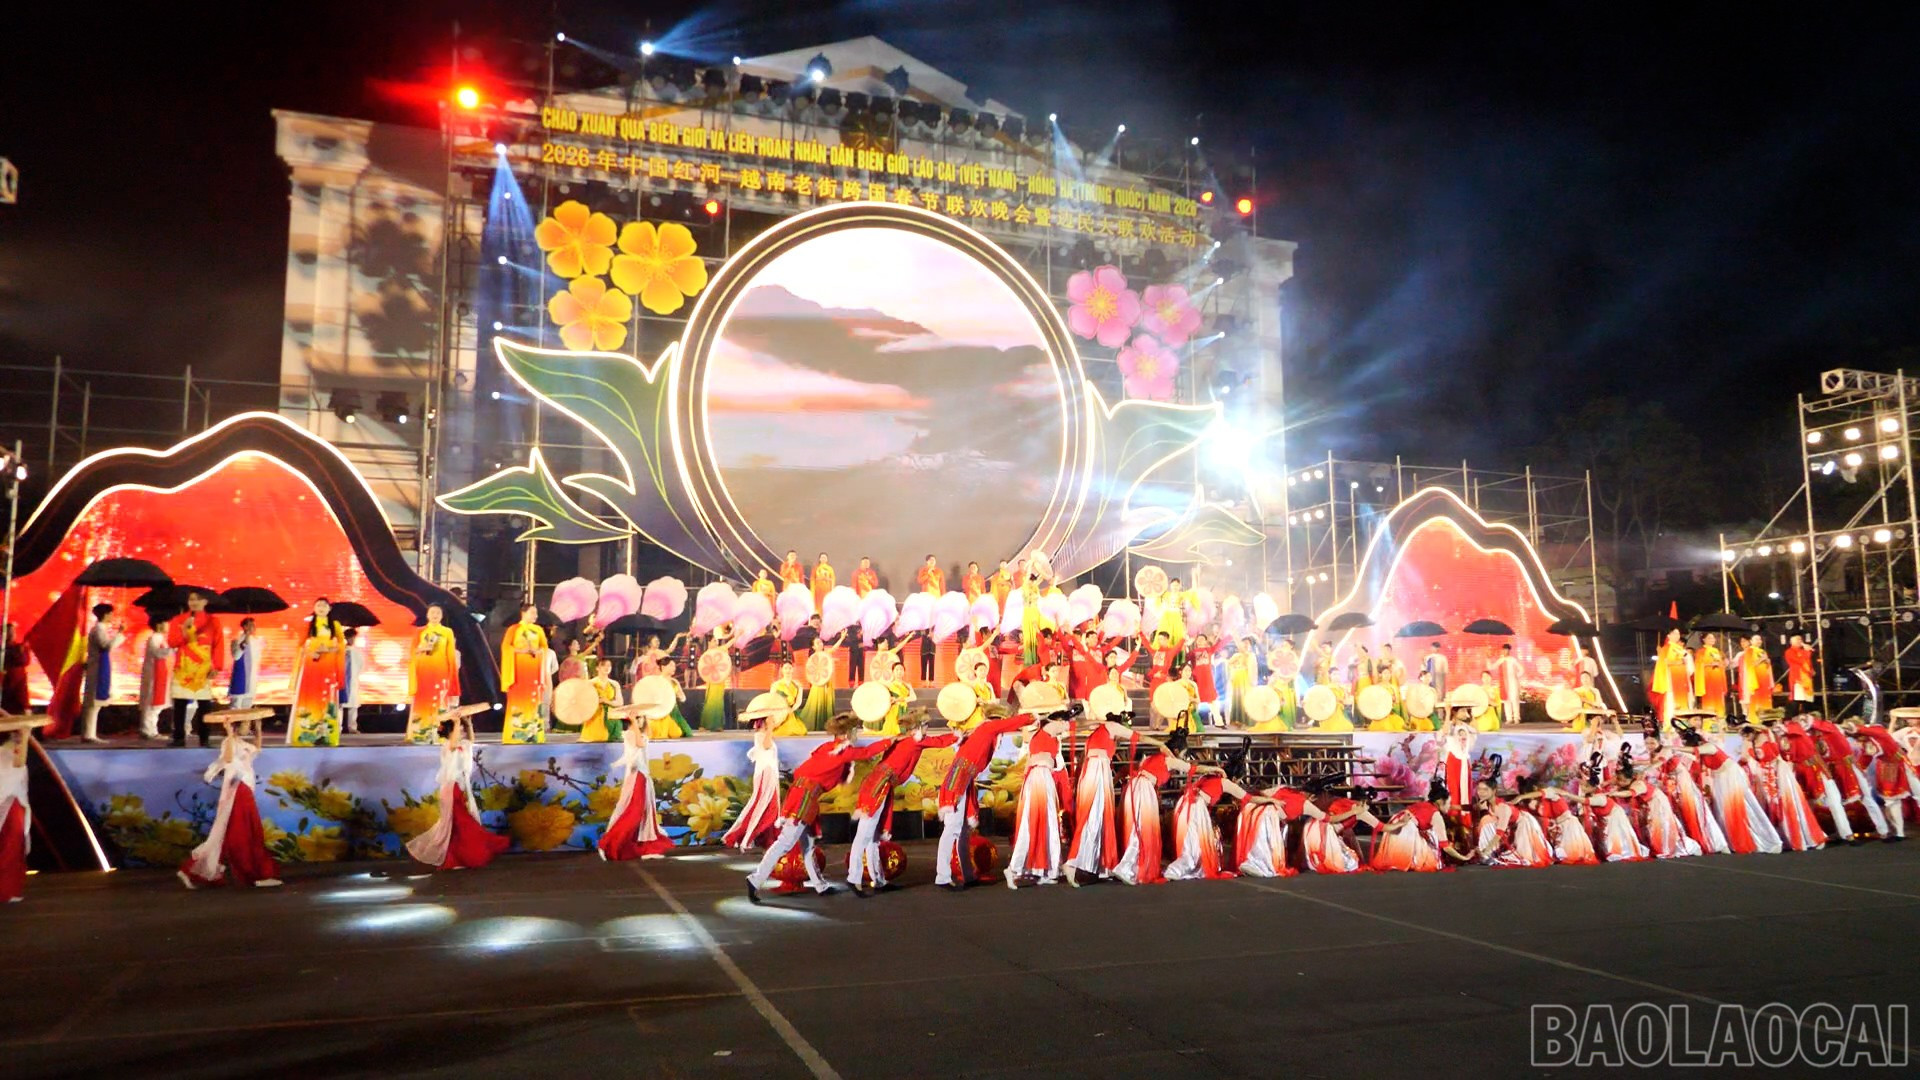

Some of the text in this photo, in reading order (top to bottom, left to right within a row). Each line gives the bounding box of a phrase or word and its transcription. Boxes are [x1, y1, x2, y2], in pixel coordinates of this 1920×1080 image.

[580, 111, 617, 137] XUÂN
[649, 120, 678, 144] BIÊN
[729, 130, 755, 155] LIÊN
[758, 137, 791, 159] HOAN
[794, 139, 827, 164] NHÂN
[830, 143, 854, 167] DÂN
[858, 147, 884, 172] BIÊN
[887, 150, 909, 175] GIỚI
[938, 161, 956, 182] CAI
[960, 162, 985, 190] (VIỆT
[988, 169, 1017, 192] NAM)
[1115, 184, 1145, 211] QUỐC)
[1174, 197, 1197, 217] 2026
